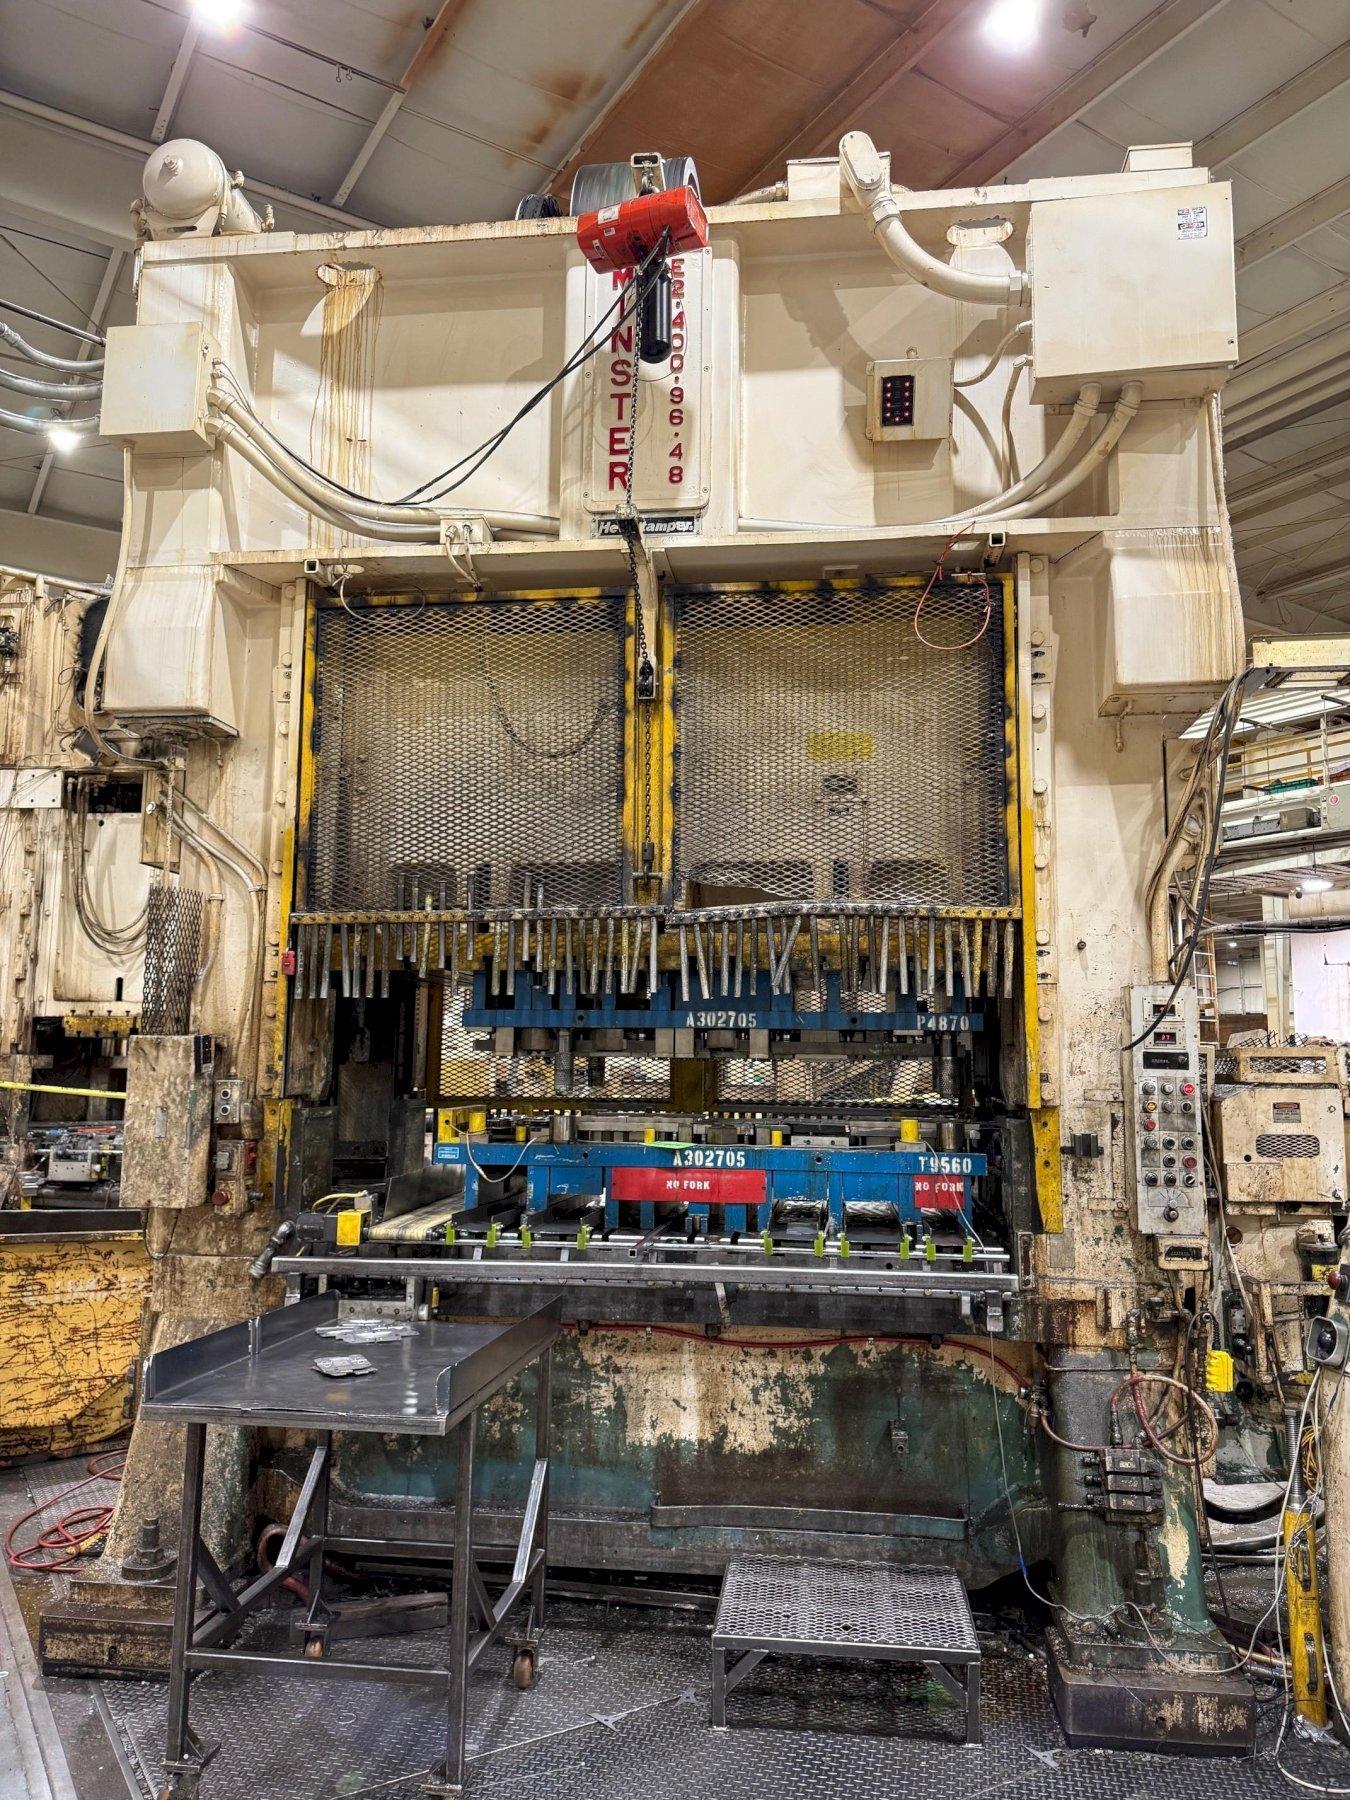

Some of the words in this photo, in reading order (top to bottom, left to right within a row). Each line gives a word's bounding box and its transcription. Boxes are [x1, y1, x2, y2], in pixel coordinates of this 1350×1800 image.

[608, 266, 634, 491] MINSTER
[686, 1011, 757, 1028] A302705
[916, 1015, 970, 1031] P4870
[673, 1150, 745, 1168] A302705
[918, 1156, 972, 1173] T9560
[666, 1180, 679, 1189] NO
[684, 1180, 710, 1190] FORK
[914, 1181, 930, 1191] NO
[934, 1181, 964, 1193] FORK
